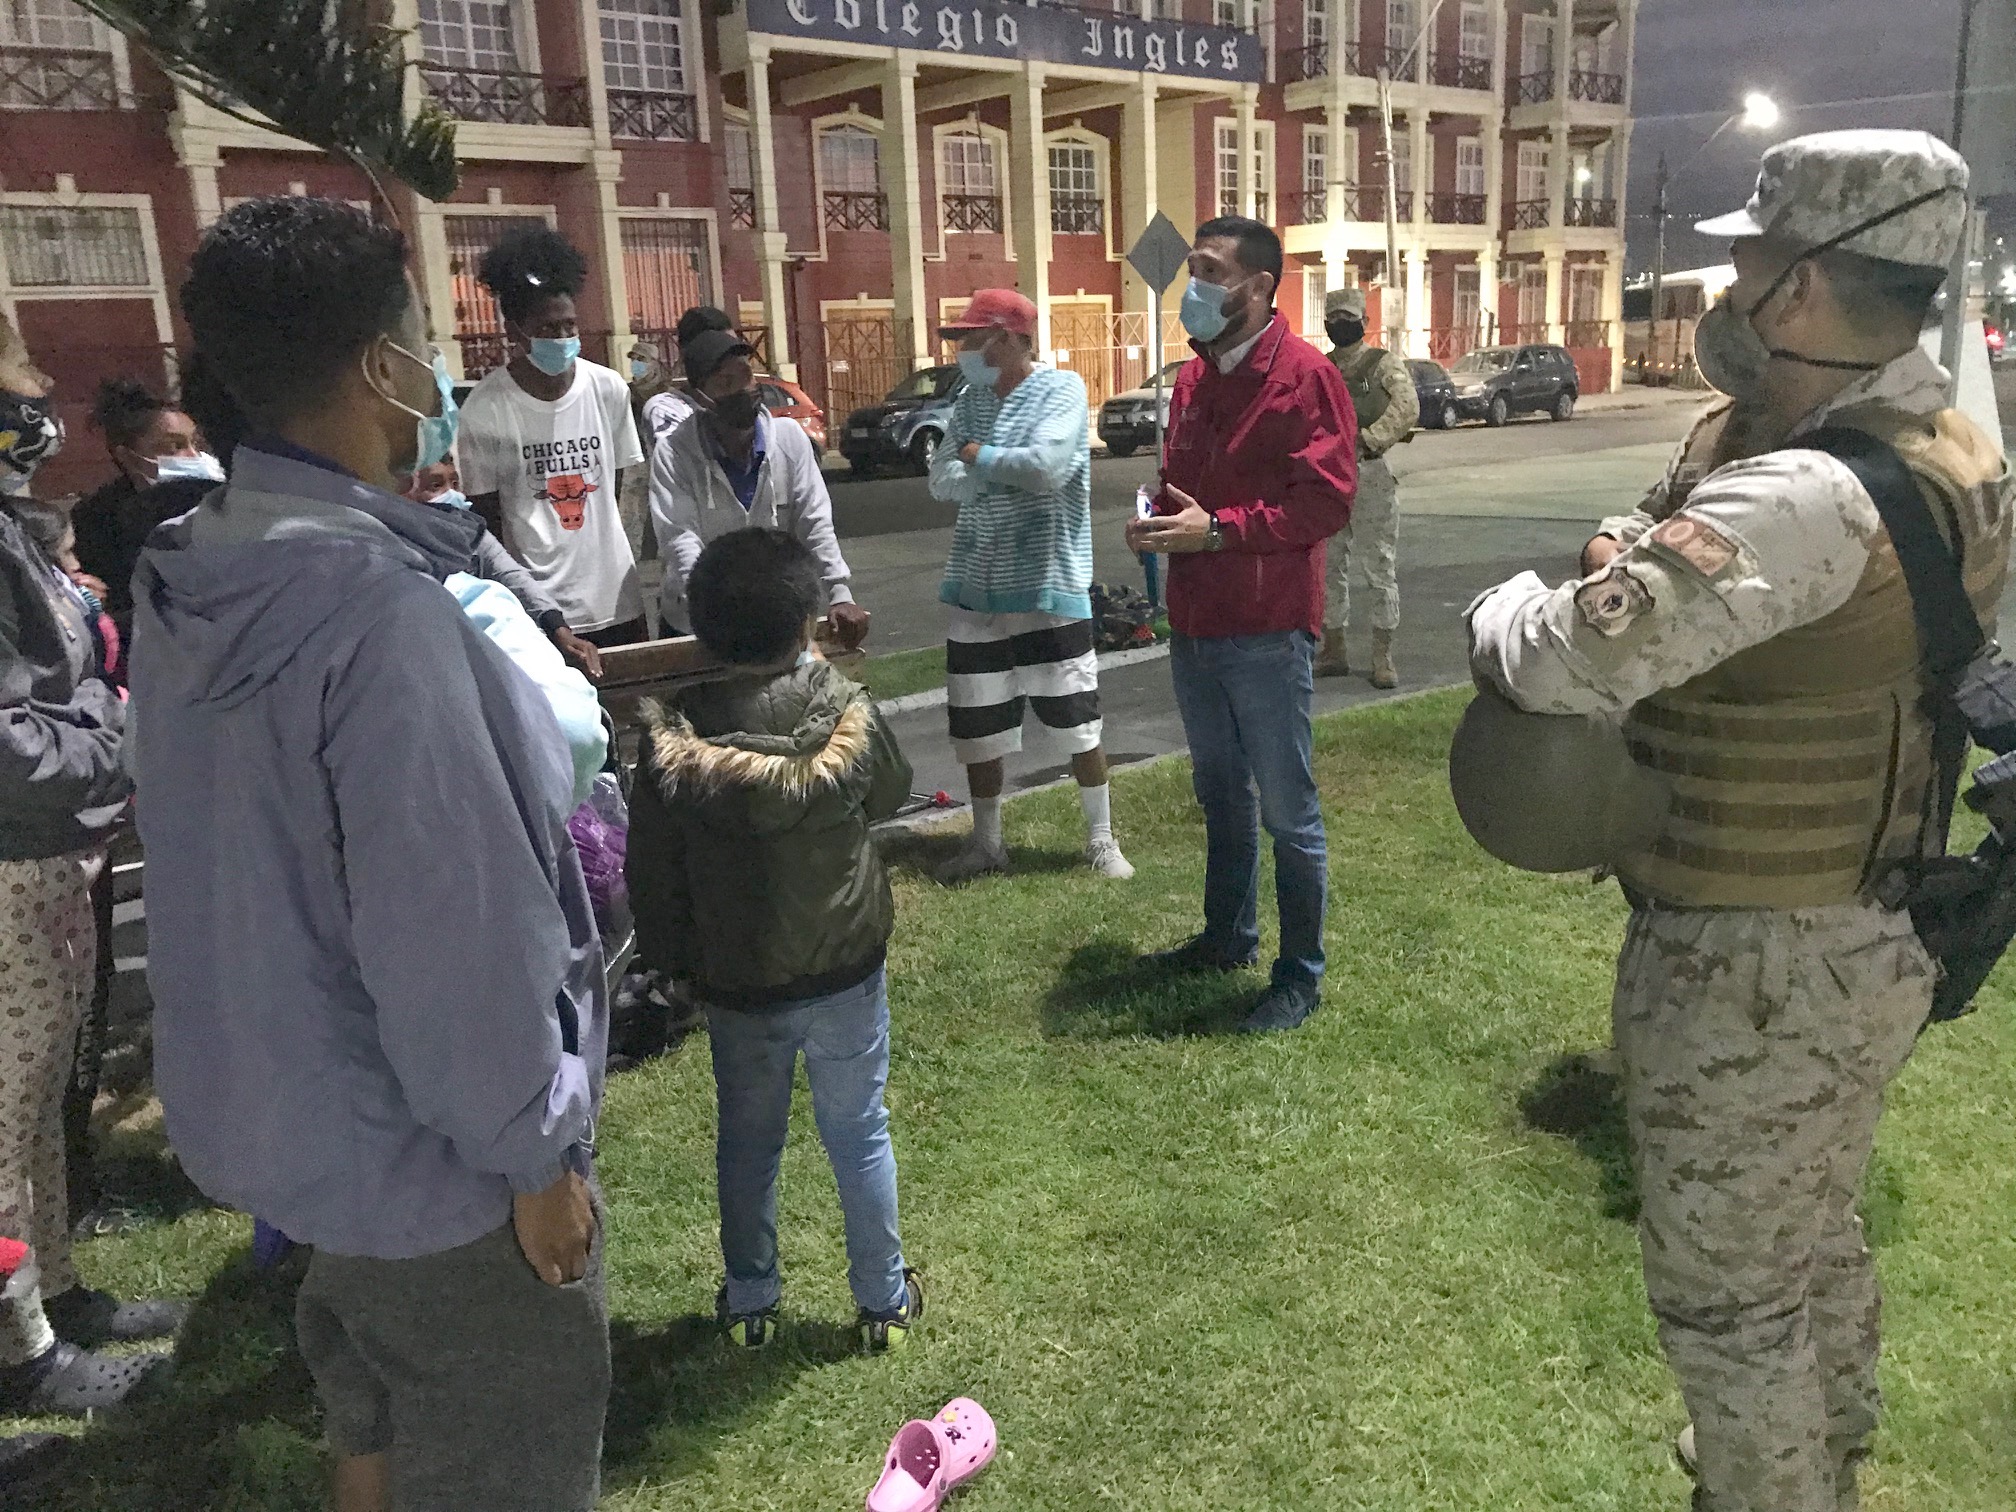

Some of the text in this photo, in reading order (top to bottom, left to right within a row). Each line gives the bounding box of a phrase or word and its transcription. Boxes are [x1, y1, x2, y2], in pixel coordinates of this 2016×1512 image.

[786, 0, 1239, 72] Colegio Ingles
[522, 436, 601, 460] CHICAGO
[535, 454, 590, 474] BULLS
